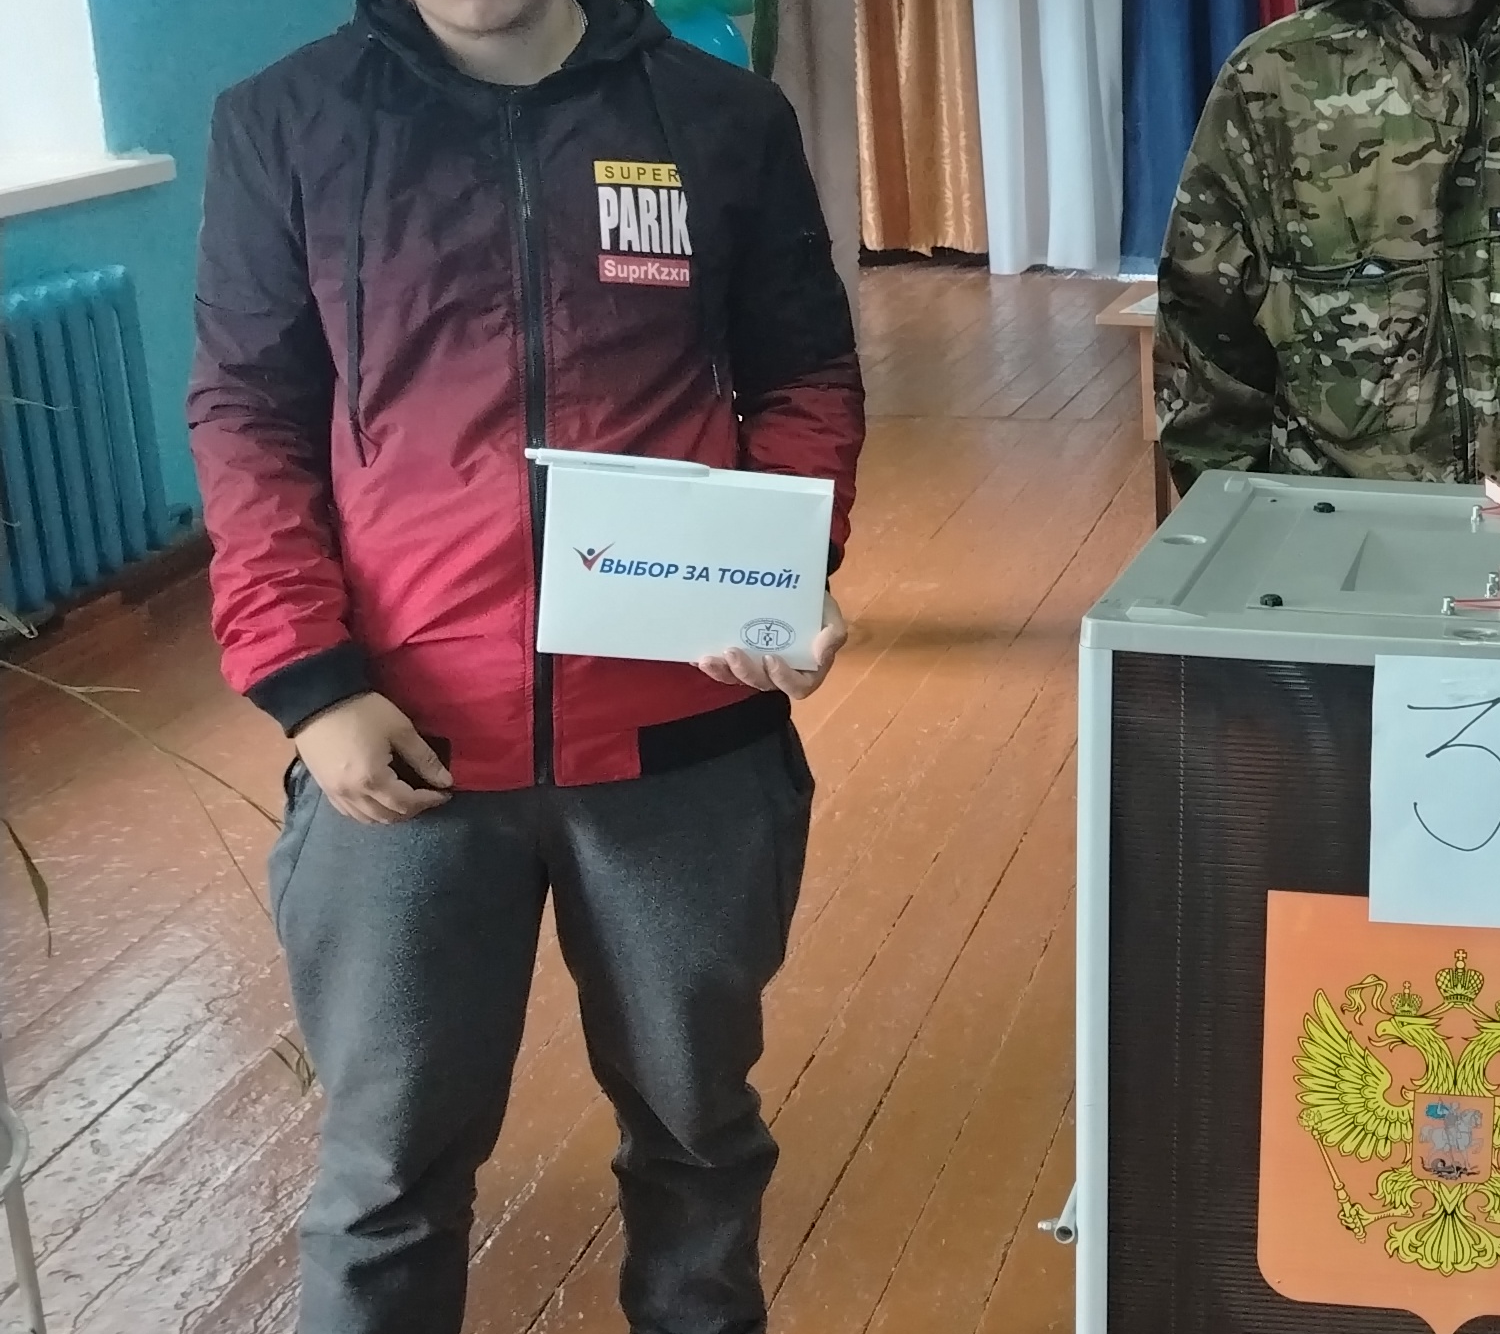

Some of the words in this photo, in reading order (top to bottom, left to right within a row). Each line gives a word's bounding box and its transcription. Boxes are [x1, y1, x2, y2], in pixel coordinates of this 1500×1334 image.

[604, 165, 680, 183] SUPER
[597, 186, 693, 256] PARIK
[604, 259, 690, 282] SuprKzxn
[599, 557, 680, 579] ВЫБОР
[682, 565, 710, 582] ЗА
[718, 568, 801, 590] ТОБОЙ!
